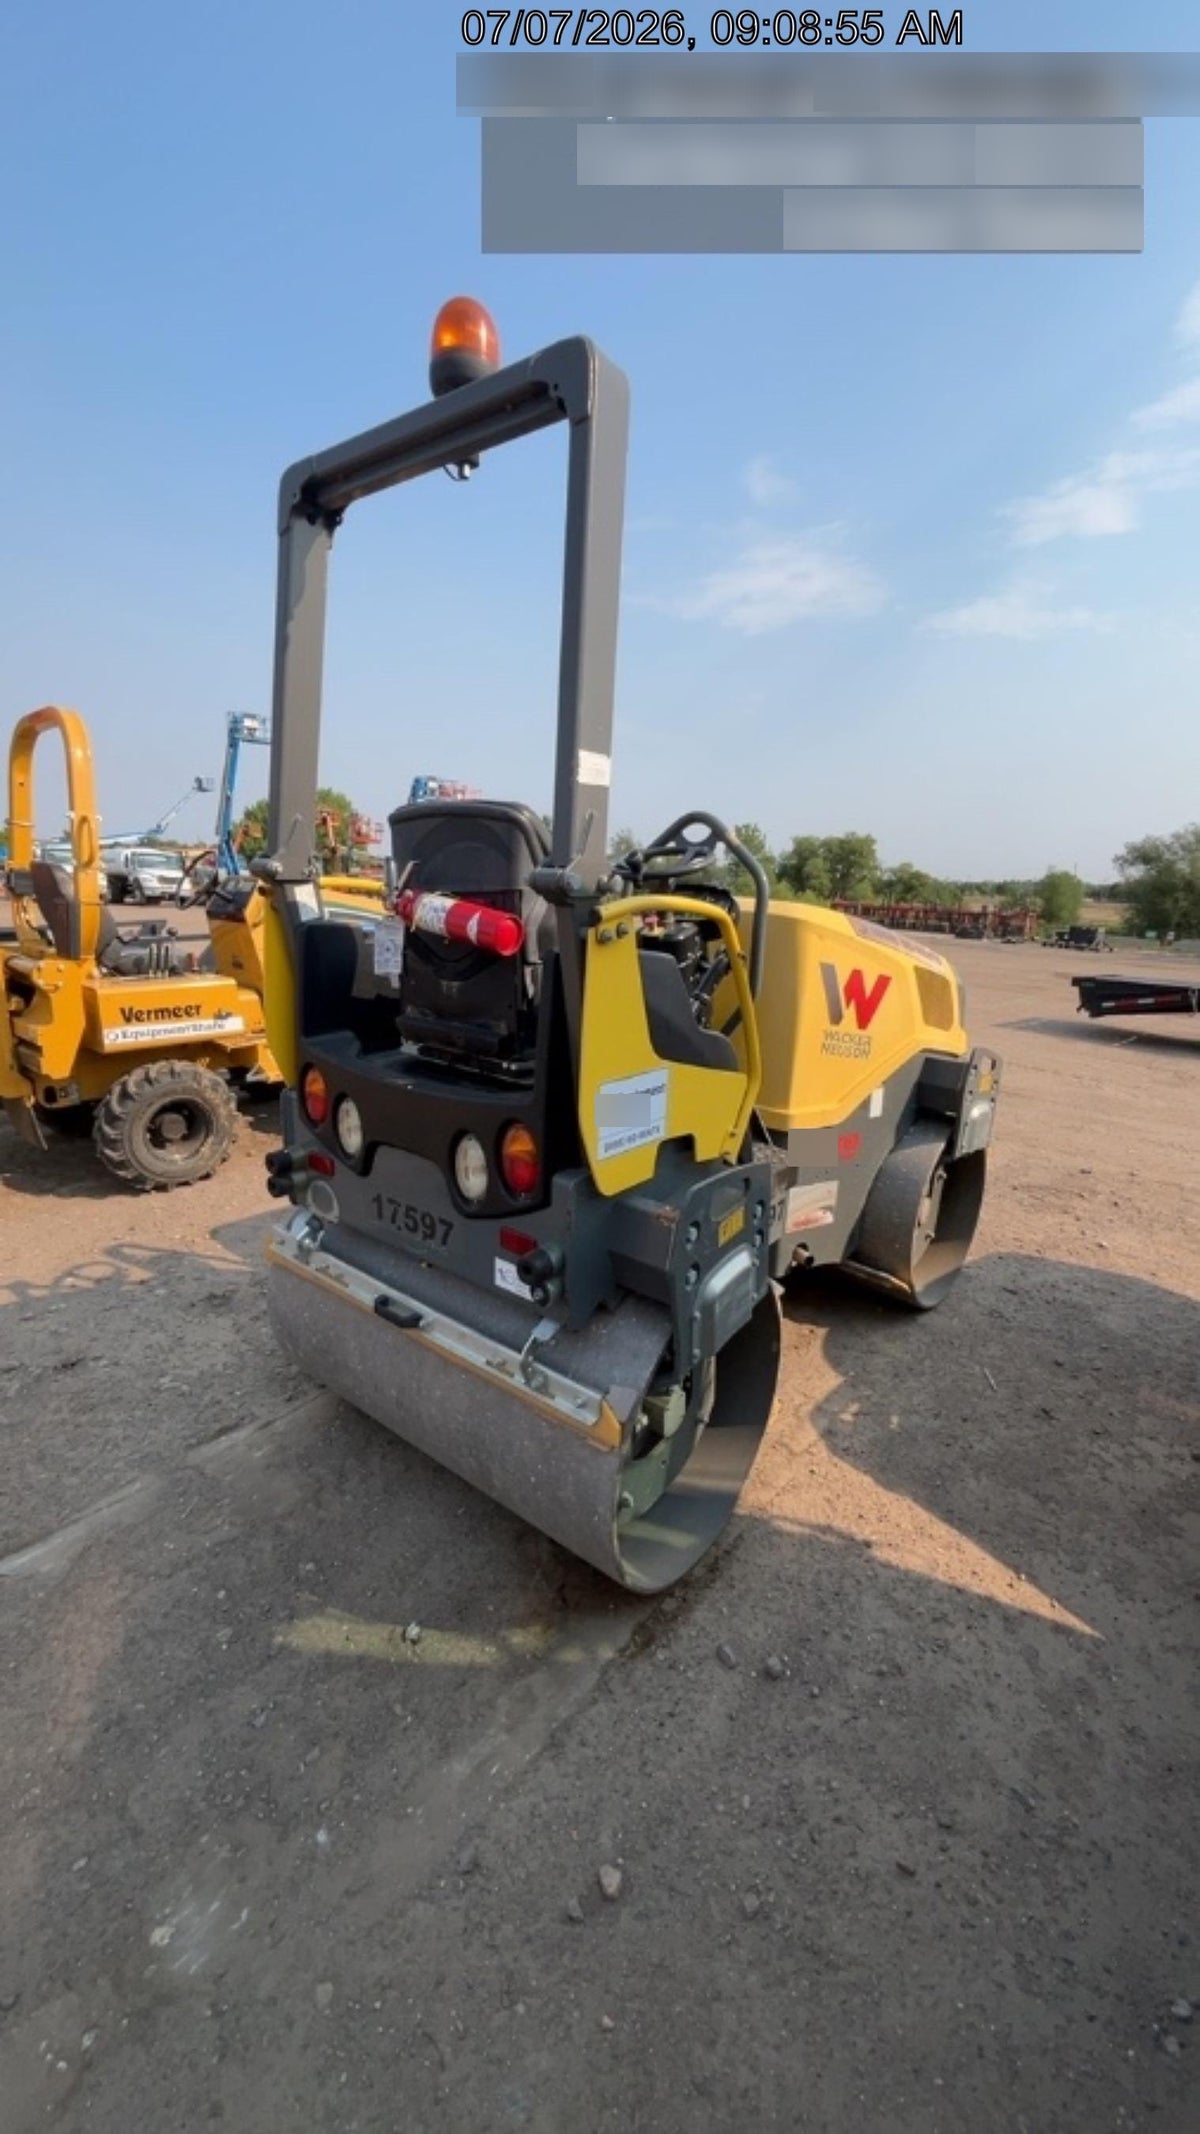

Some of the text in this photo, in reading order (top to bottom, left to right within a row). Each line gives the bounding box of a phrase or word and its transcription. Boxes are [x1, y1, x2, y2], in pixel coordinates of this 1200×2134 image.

[119, 1004, 202, 1024] Vermeer
[823, 1030, 872, 1047] WACKER
[820, 1041, 871, 1059] NEUSON
